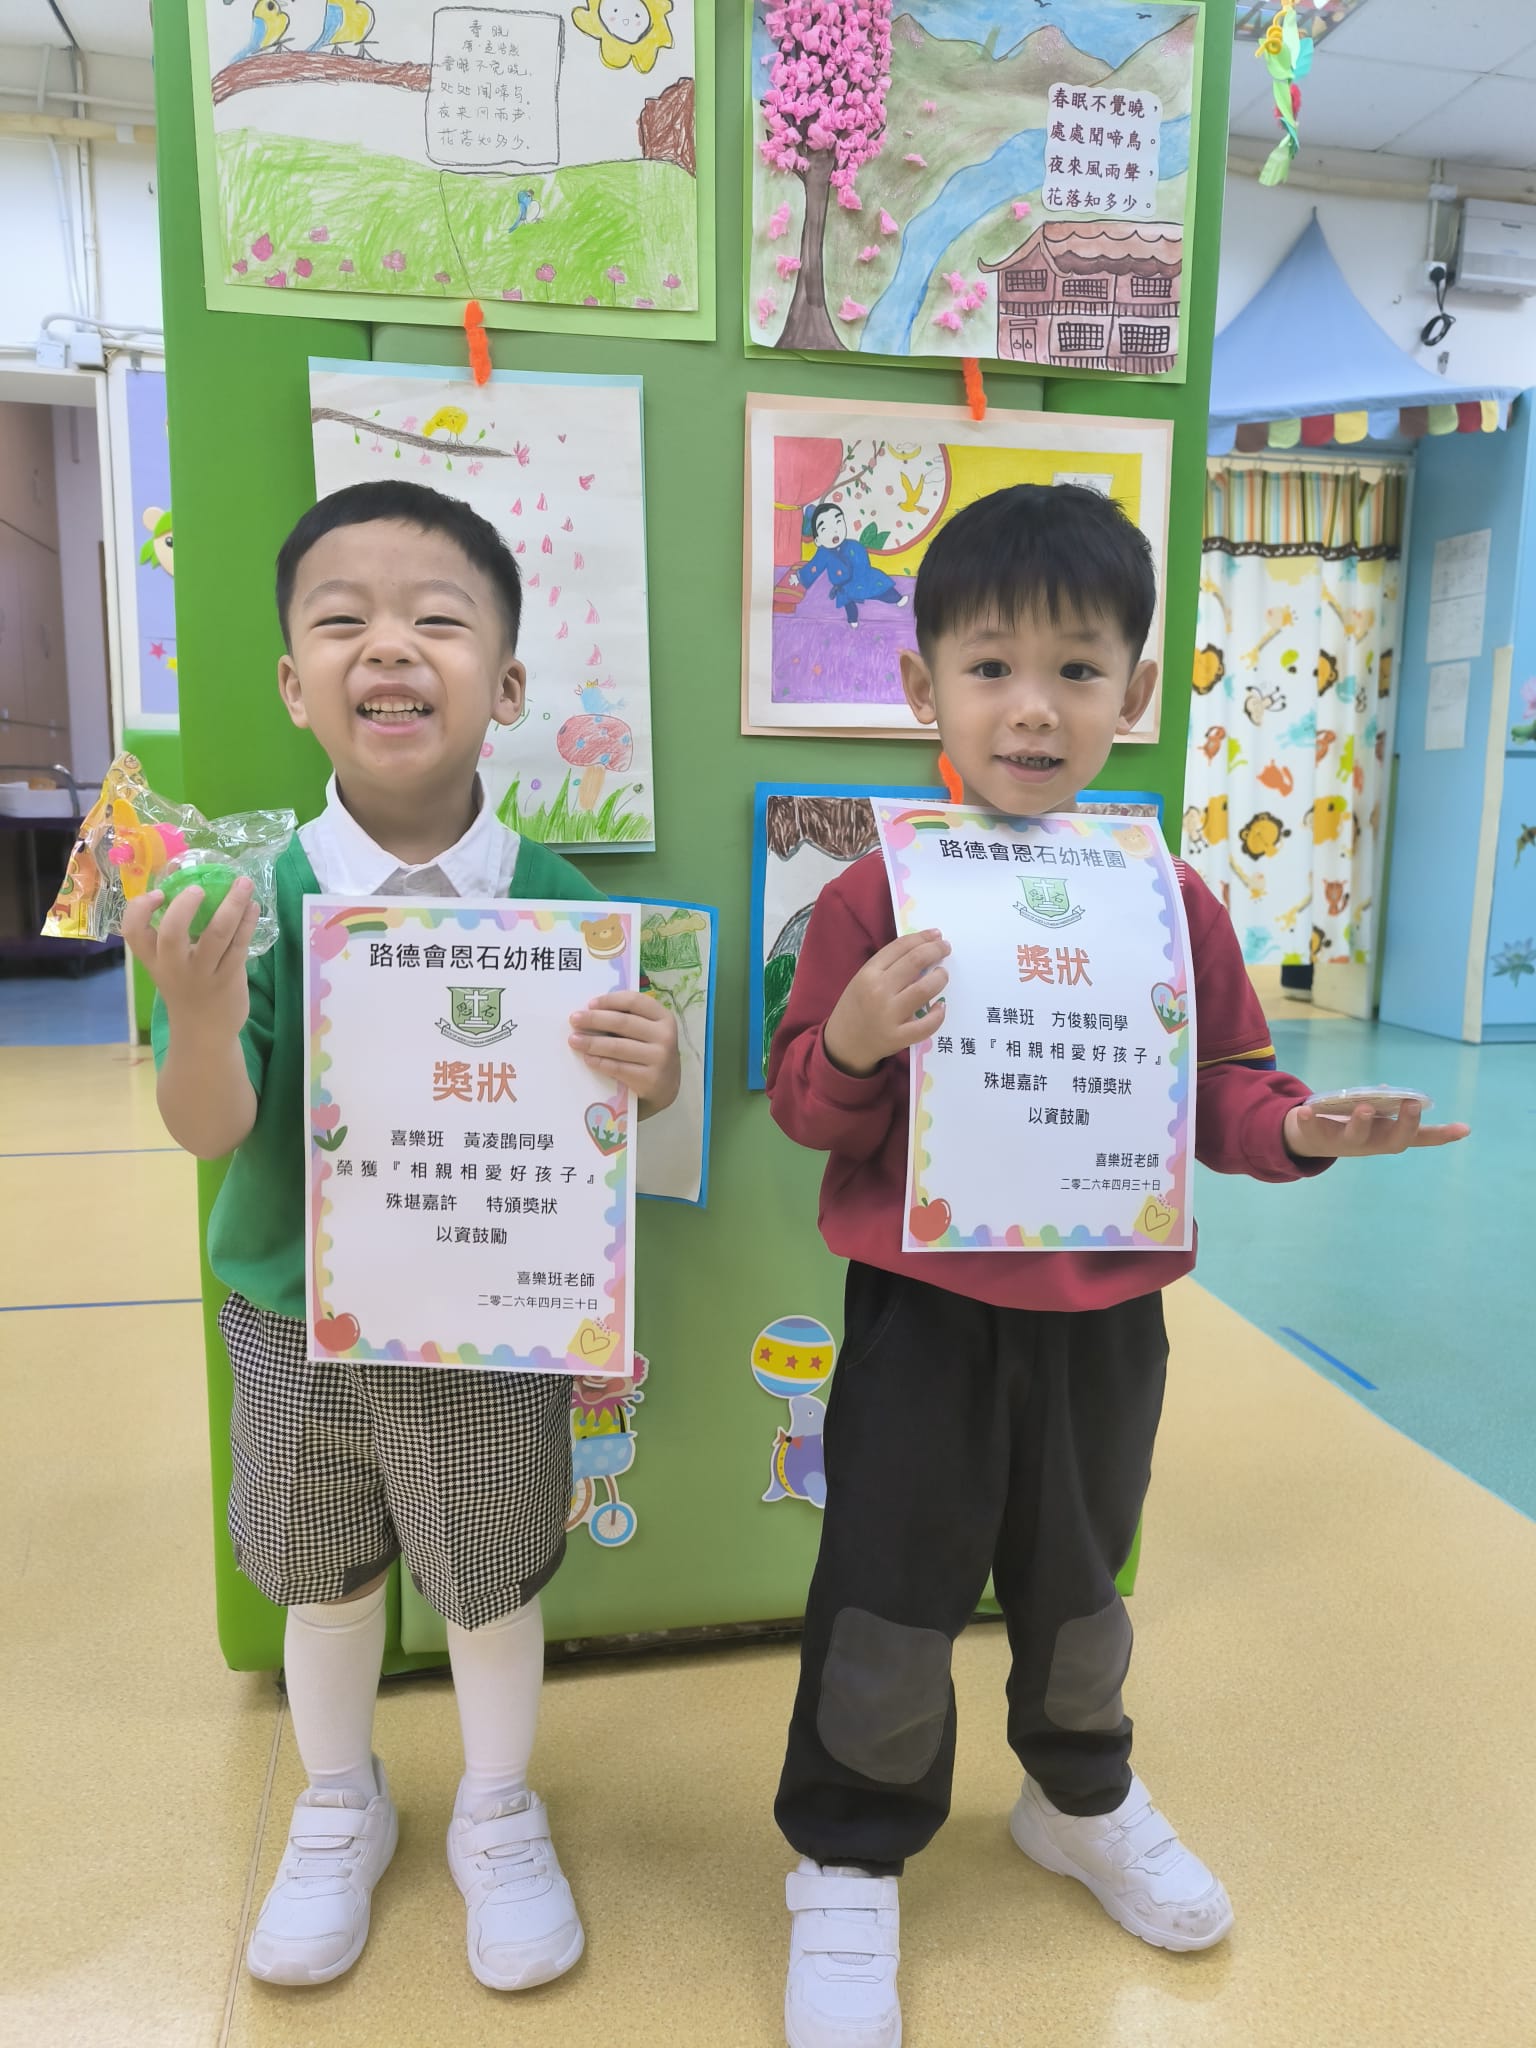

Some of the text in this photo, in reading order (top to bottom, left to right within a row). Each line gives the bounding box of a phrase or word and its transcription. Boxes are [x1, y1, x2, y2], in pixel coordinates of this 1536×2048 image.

[939, 838, 1127, 870] 路德會恩石幼稚園
[369, 942, 583, 972] 路德會恩石幼稚園
[1016, 944, 1093, 987] 獎狀
[986, 1006, 1129, 1031] 喜樂班 方俊毅同學
[937, 1036, 1163, 1066] 榮獲『相親相愛好孩子』
[432, 1060, 517, 1104] 獎狀
[984, 1071, 1132, 1095] 殊堪嘉許 特頒獎狀
[1028, 1106, 1090, 1126] 以資鼓勵
[390, 1129, 445, 1148] 喜樂班
[336, 1159, 596, 1185] 榮獲『相親相愛好孩子』
[1095, 1152, 1160, 1169] 喜樂班老師
[1060, 1178, 1161, 1192] 二零二六年四月三十日
[386, 1192, 558, 1215] 殊堪嘉許 特頒獎狀
[435, 1225, 507, 1245] 以資鼓勵
[516, 1271, 595, 1288] 喜樂班老師
[477, 1294, 598, 1311] 二零二六年四月三十日
